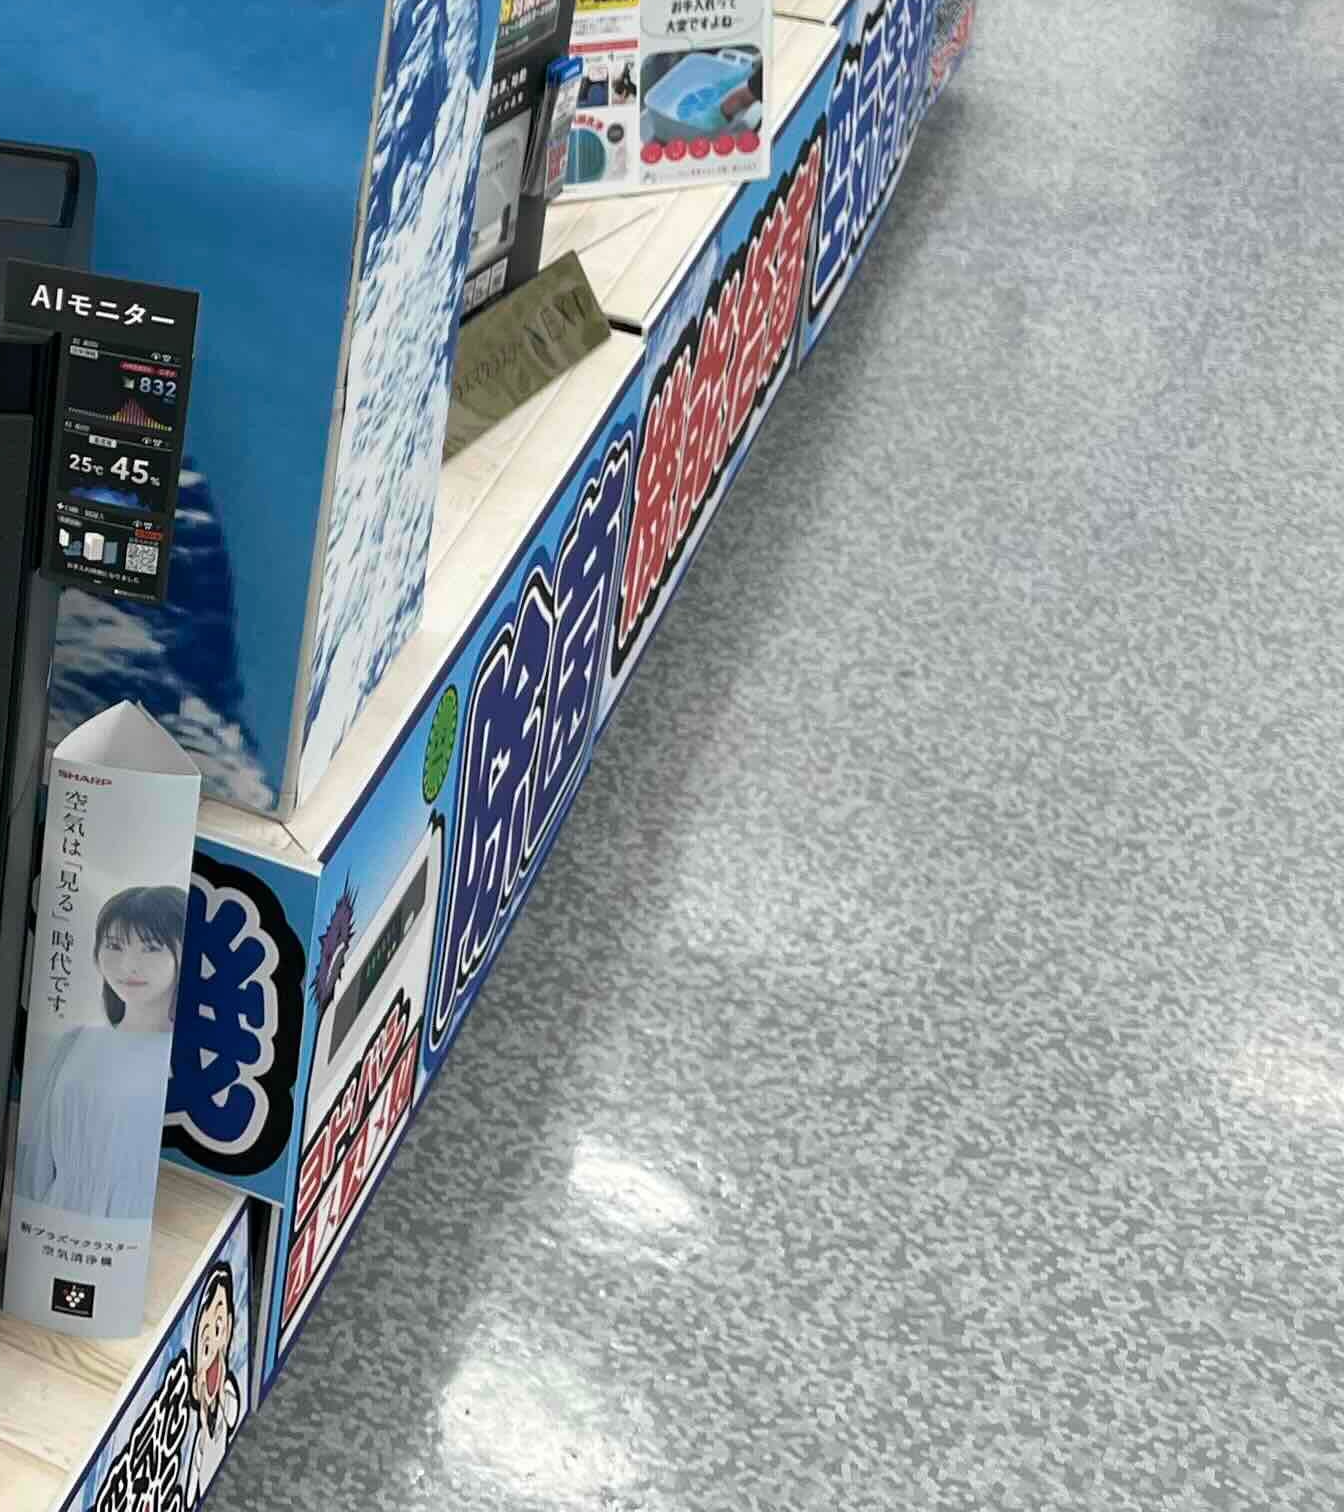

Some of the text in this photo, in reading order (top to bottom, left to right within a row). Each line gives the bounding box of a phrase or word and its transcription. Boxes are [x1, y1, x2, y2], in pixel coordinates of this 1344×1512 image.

[31, 284, 175, 326] AIモニター
[139, 375, 178, 397] 832
[58, 769, 113, 786] SHARP
[45, 789, 90, 1022] 空気は「見る」時代です。
[294, 1000, 408, 1232] ヨドバシ
